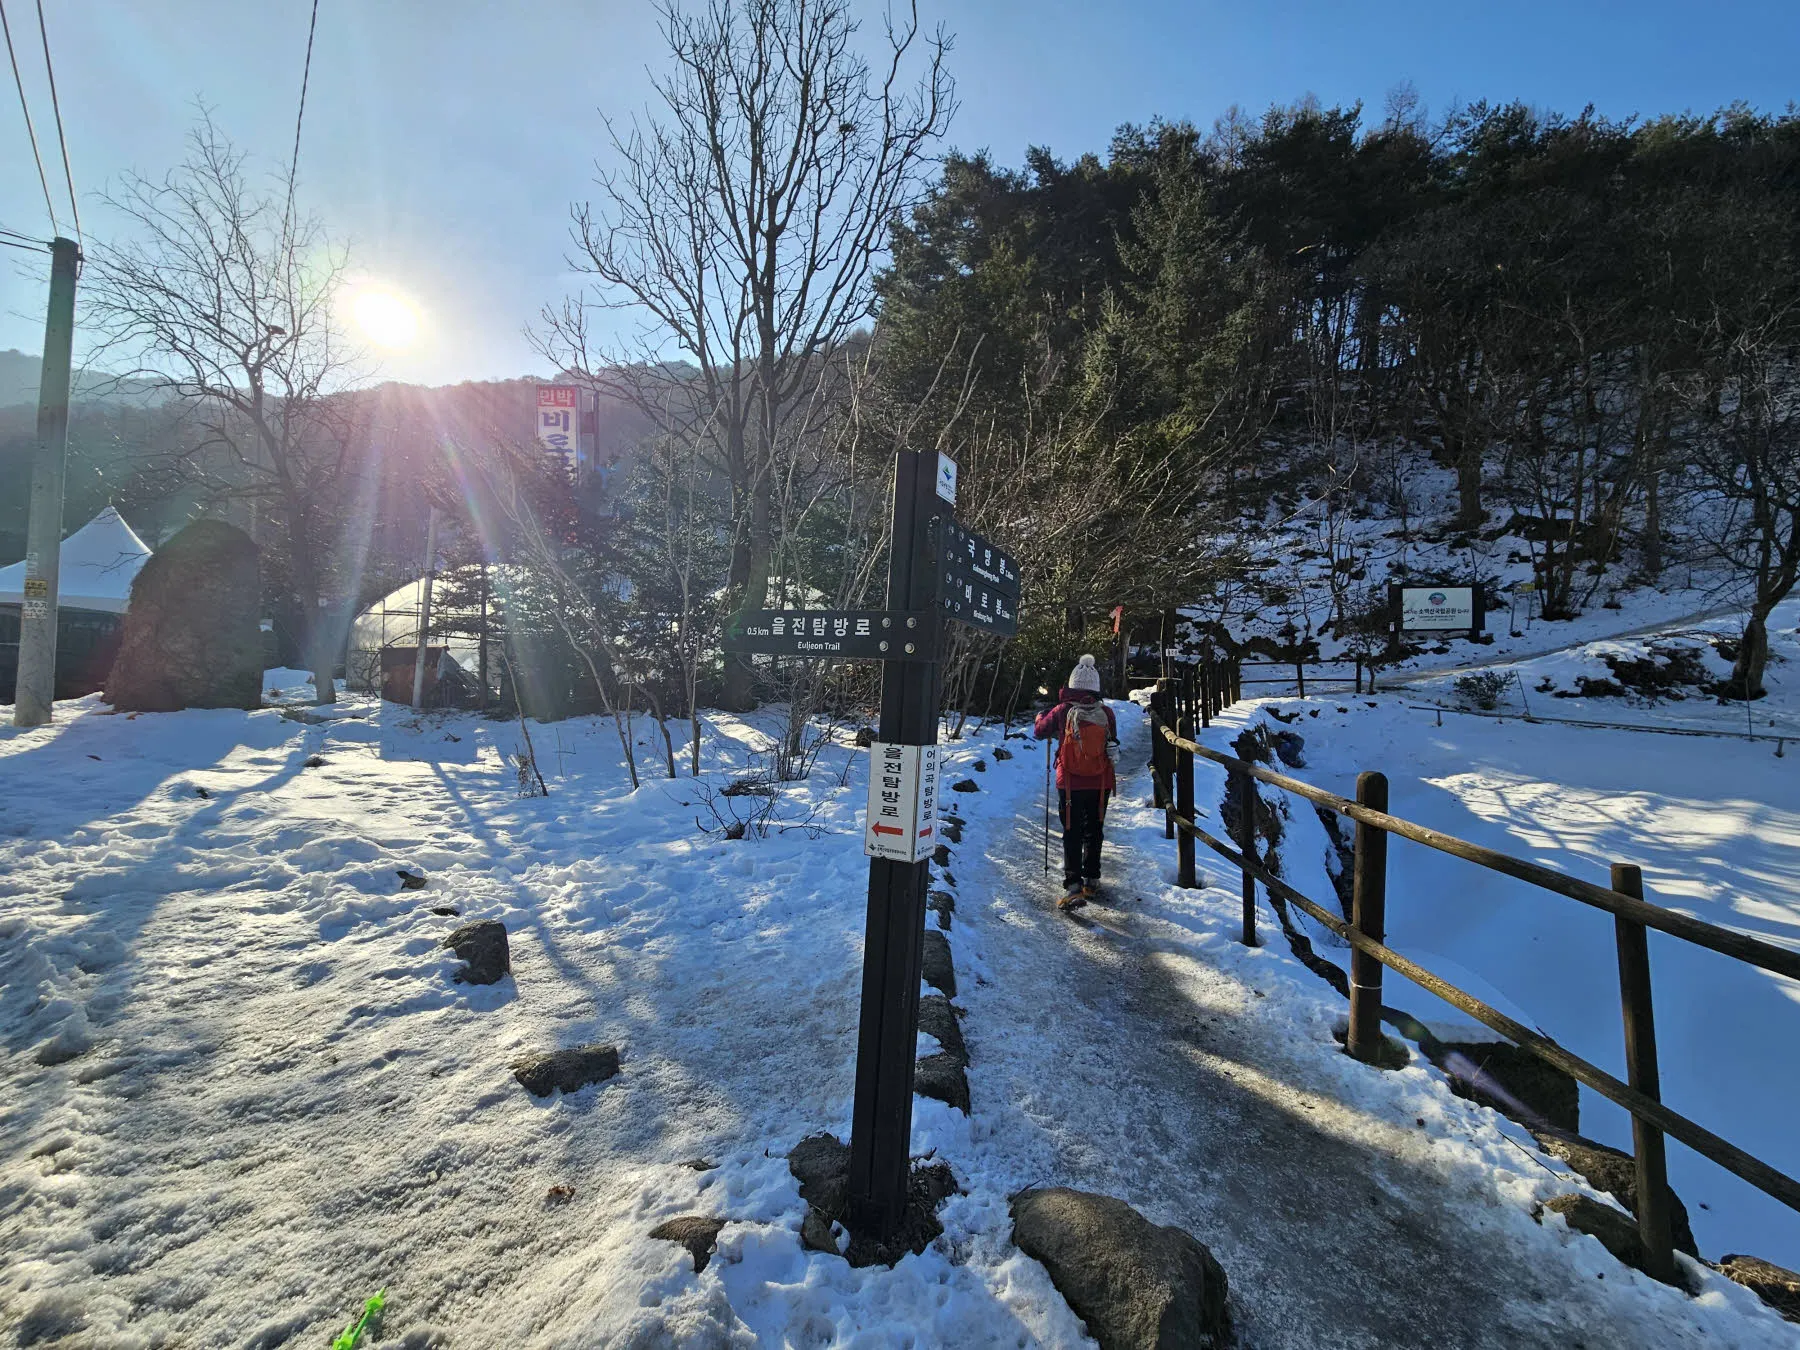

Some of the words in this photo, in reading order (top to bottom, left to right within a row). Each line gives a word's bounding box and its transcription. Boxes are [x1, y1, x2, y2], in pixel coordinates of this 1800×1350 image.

[968, 539, 1005, 575] 국망봉
[965, 585, 1002, 615] 비로봉
[772, 616, 870, 637] 을전탐방로
[797, 641, 823, 651] Euljeon
[824, 642, 840, 651] Trail
[880, 747, 903, 817] 을전탐방로
[923, 749, 936, 821] 어의곡탐방로
